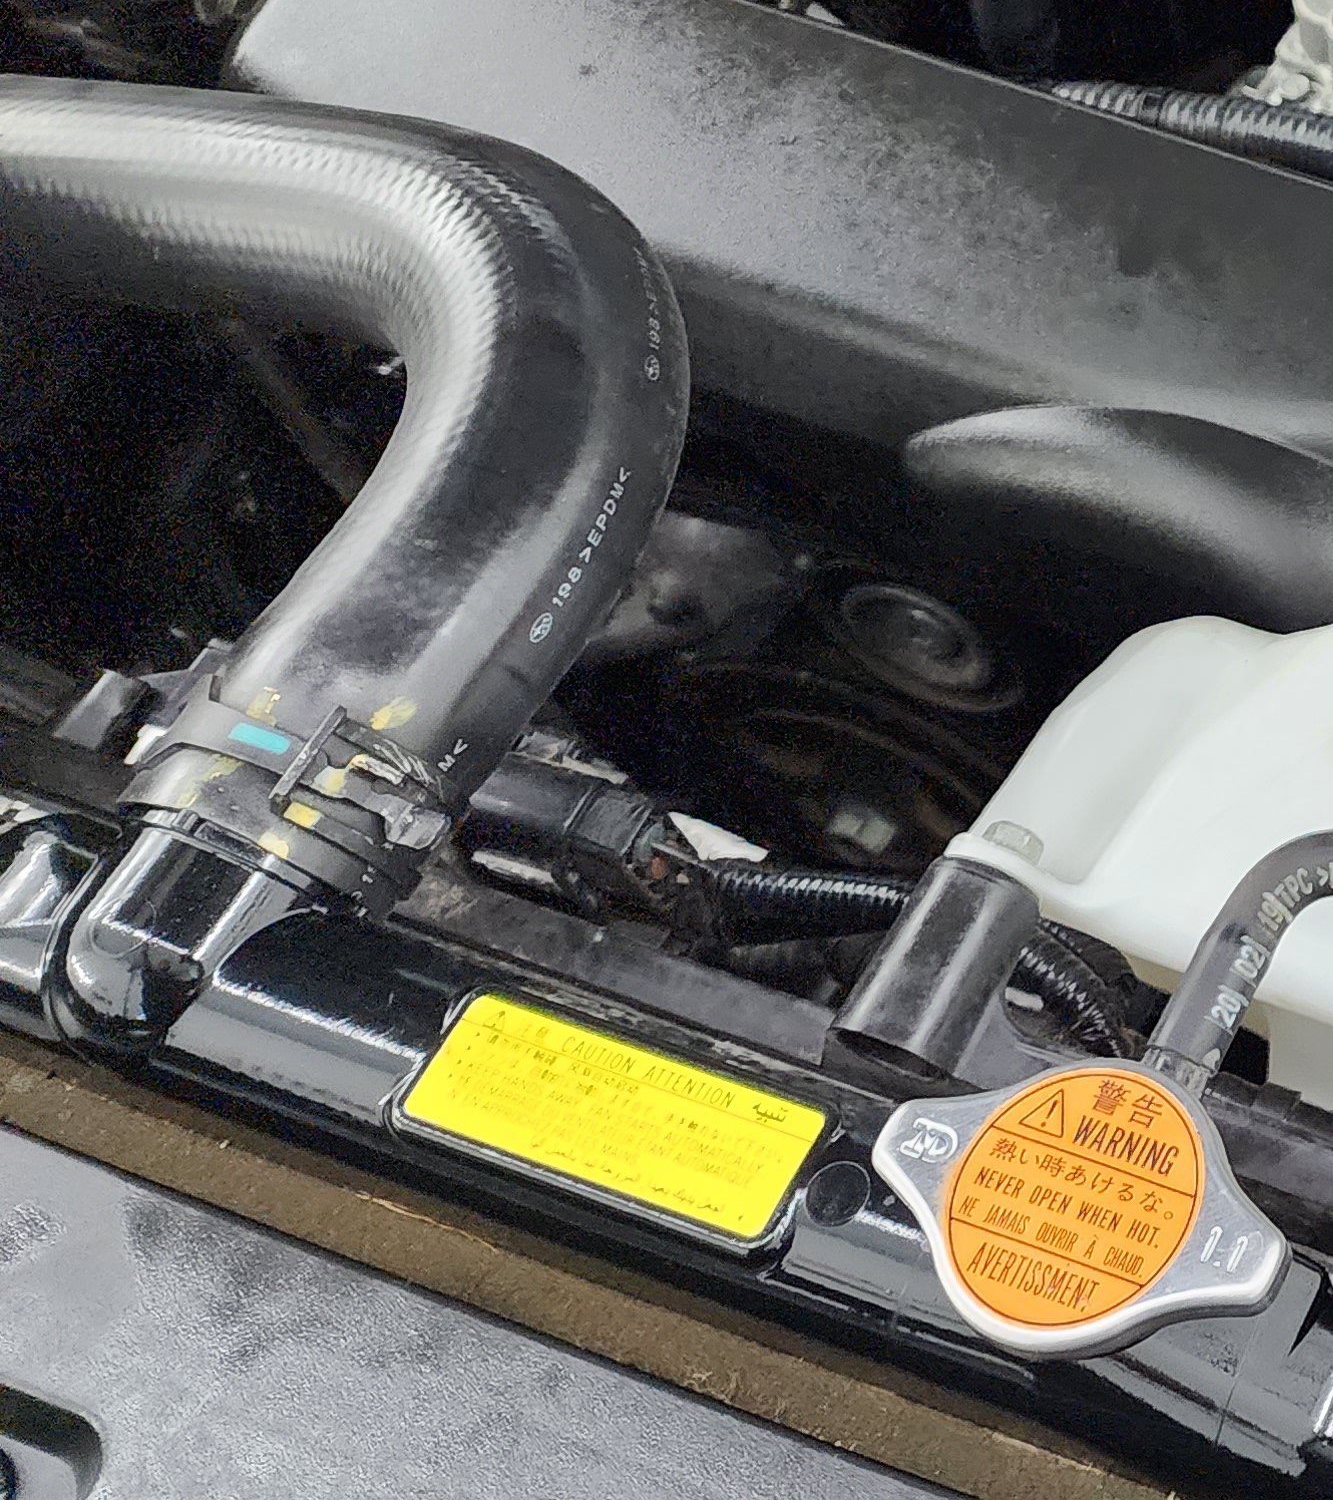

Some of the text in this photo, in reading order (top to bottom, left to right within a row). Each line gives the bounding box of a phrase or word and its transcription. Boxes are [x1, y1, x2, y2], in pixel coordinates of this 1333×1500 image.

[552, 567, 583, 609] 198
[561, 1035, 634, 1075] CAUTION
[643, 1063, 734, 1109] ATTENTION
[1091, 1078, 1165, 1130] 警告
[663, 1130, 762, 1175] AUTOMATICALLY
[1073, 1115, 1179, 1176] WARNING
[974, 1166, 1162, 1247] NEVER OPEN WHEN HOT.
[989, 1136, 1178, 1220] 熱い時あけるな。
[959, 1196, 1146, 1277] NE JAMAIS OUVRIR À CHAUD.
[1199, 1226, 1248, 1273] 1.1
